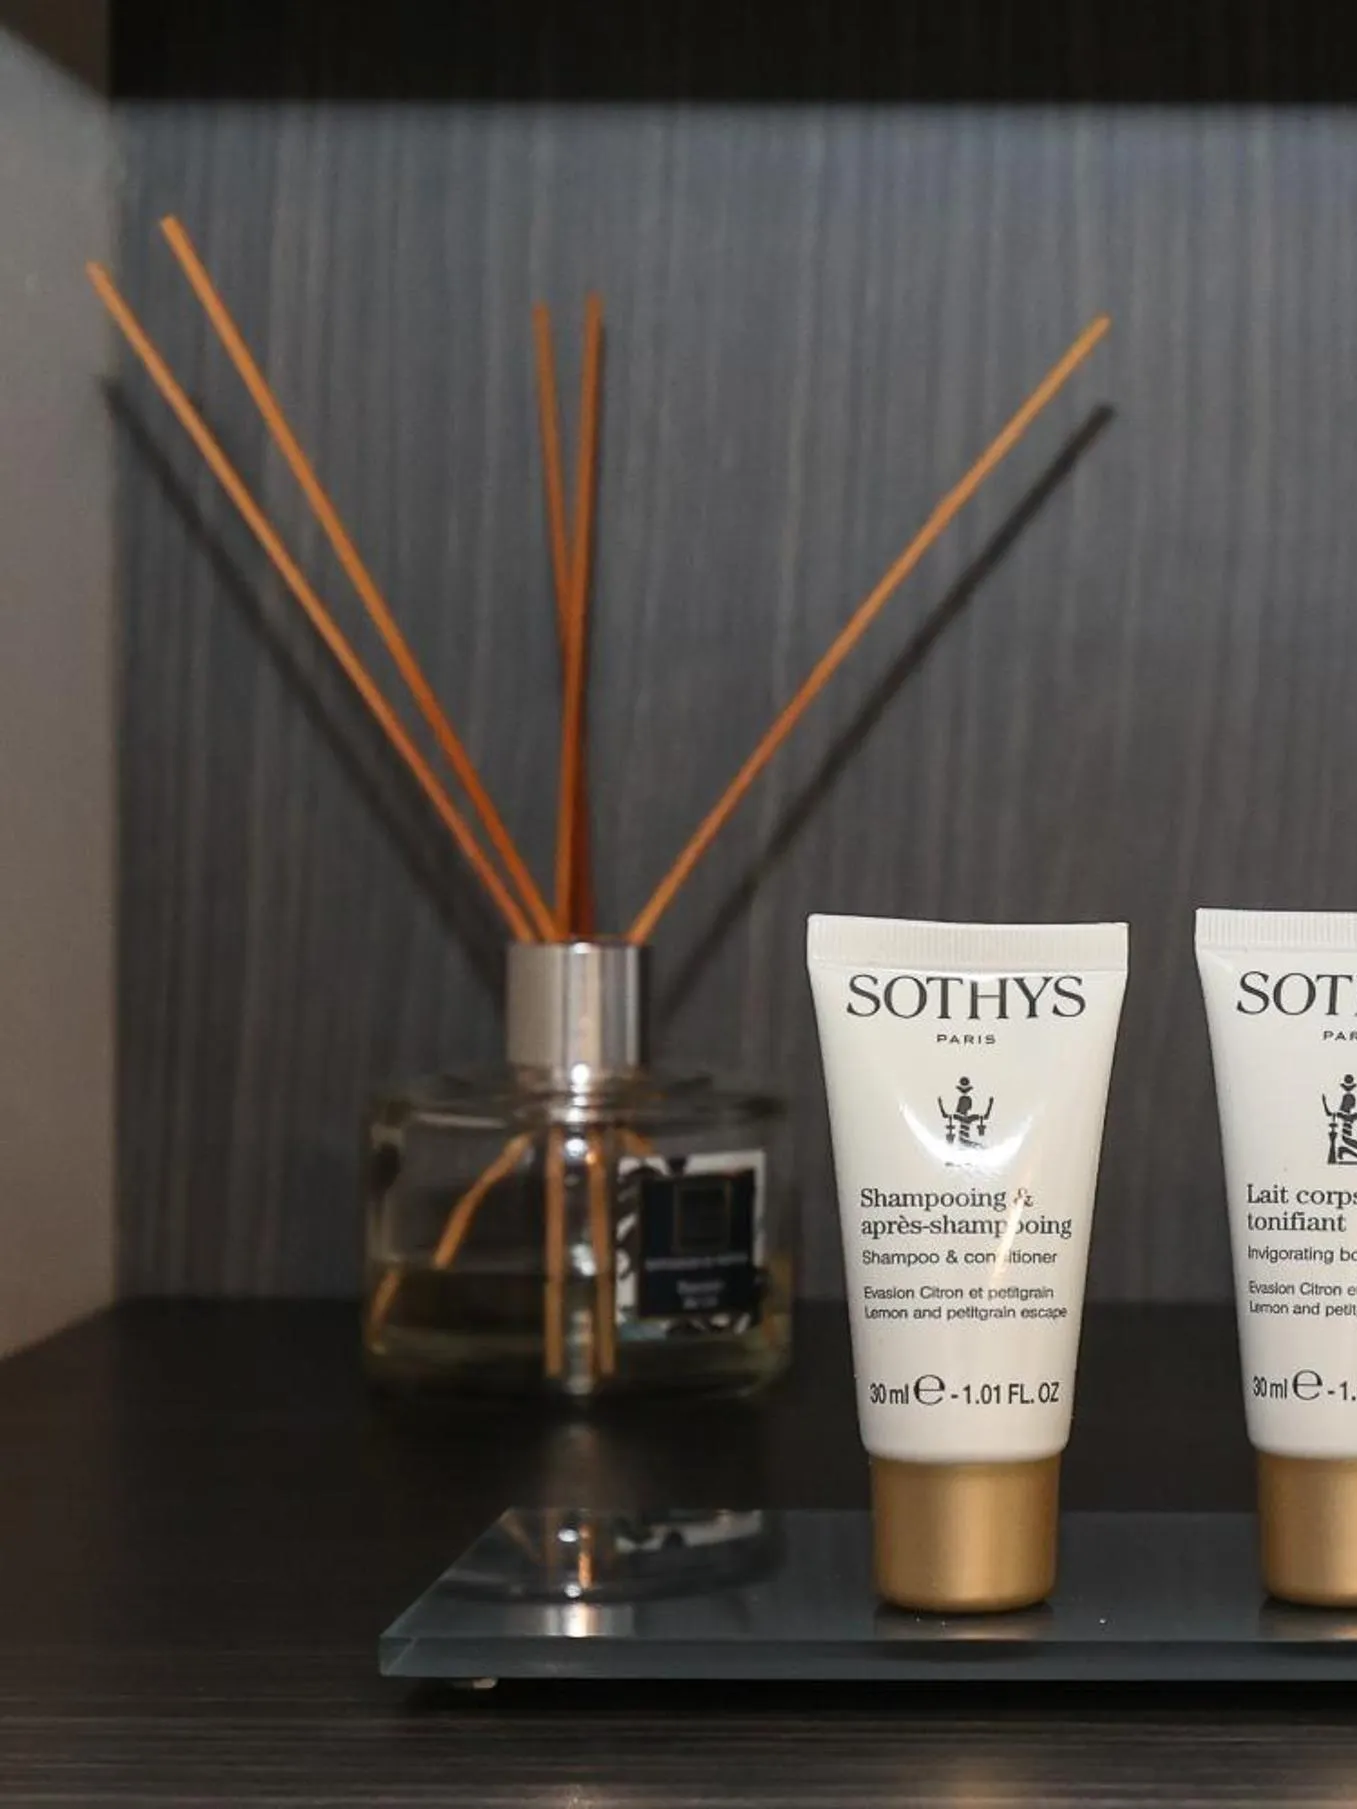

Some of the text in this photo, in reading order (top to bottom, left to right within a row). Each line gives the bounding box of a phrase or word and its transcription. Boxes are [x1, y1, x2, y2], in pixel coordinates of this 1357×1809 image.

[845, 973, 1086, 1021] SOTHYS
[936, 1034, 996, 1045] PARIS
[860, 1187, 1034, 1212] Shampooing &
[1246, 1183, 1289, 1205] Lait
[1247, 1212, 1347, 1232] tonifiant
[862, 1250, 1058, 1268] Shampoo & conitioner
[1247, 1246, 1334, 1264] Invigorating
[864, 1286, 1054, 1301] Evasion Citron et petitgrain
[1249, 1280, 1295, 1295] Evasion
[1300, 1282, 1342, 1297] Citron
[864, 1306, 1067, 1322] Lemon and petitgrain escape
[1249, 1300, 1289, 1315] Lemon
[1293, 1302, 1320, 1316] and
[869, 1382, 887, 1404] 30
[889, 1383, 909, 1405] ml
[1008, 1383, 1035, 1405] FL.
[1038, 1381, 1060, 1403] OZ
[1252, 1375, 1267, 1397] 30
[1269, 1378, 1287, 1399] ml
